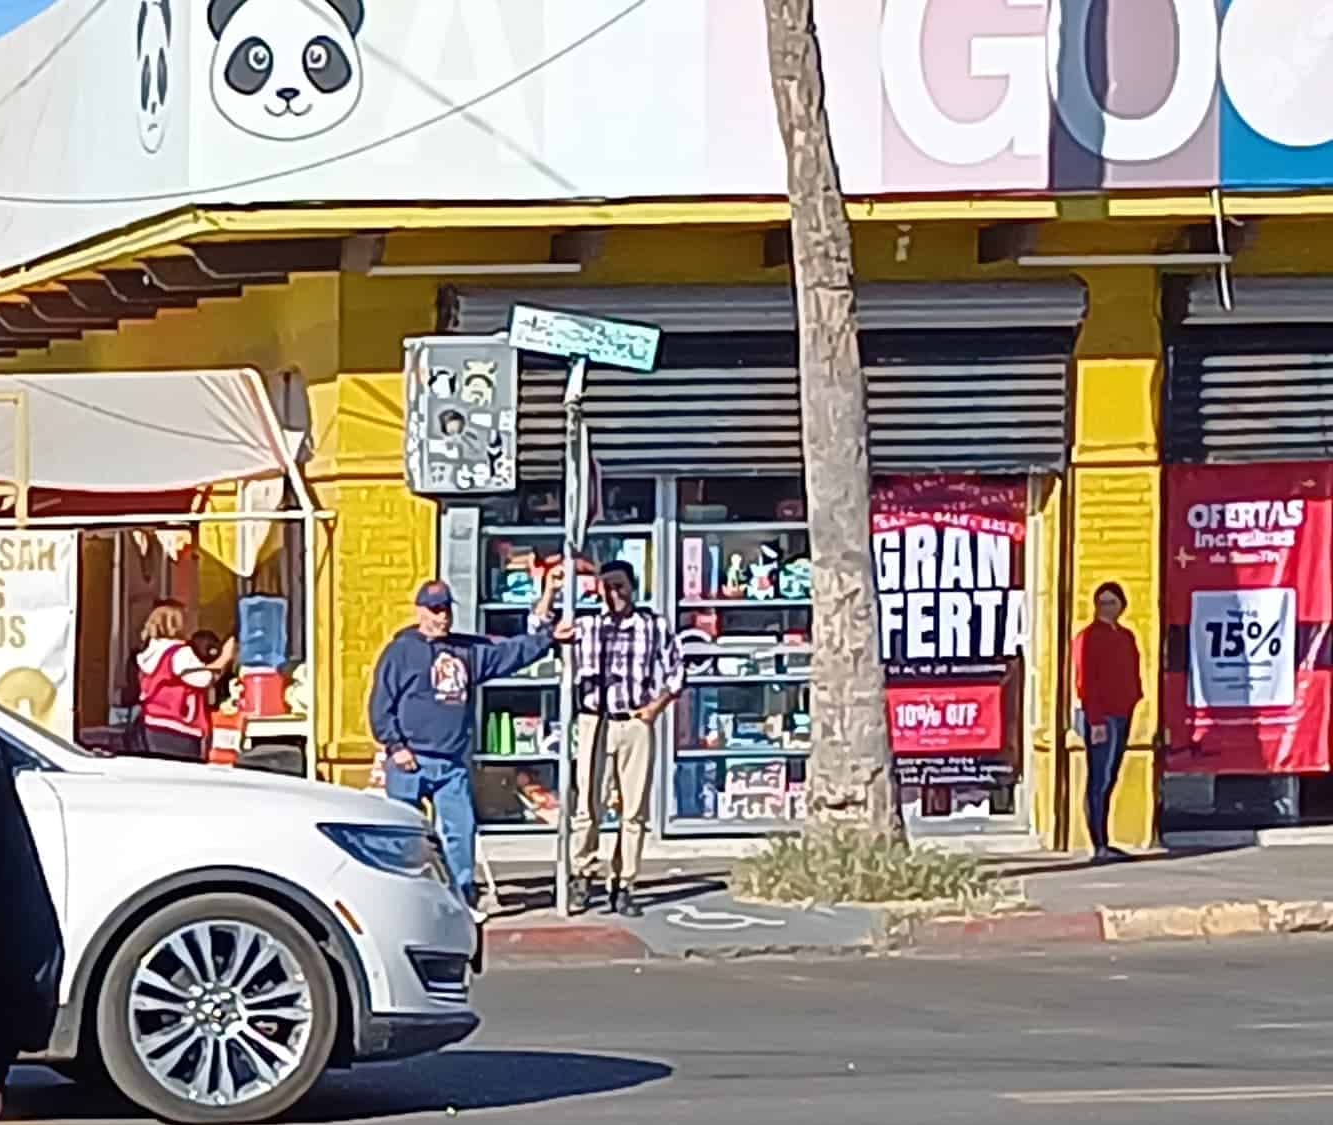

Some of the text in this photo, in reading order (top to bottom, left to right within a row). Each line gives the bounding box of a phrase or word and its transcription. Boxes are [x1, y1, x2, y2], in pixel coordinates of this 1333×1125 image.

[1187, 500, 1304, 529] OFERTAS
[872, 523, 1011, 592] GRAN
[878, 590, 1028, 660] FERTA
[1205, 620, 1282, 658] 15%
[895, 703, 979, 728] 10% OFF
